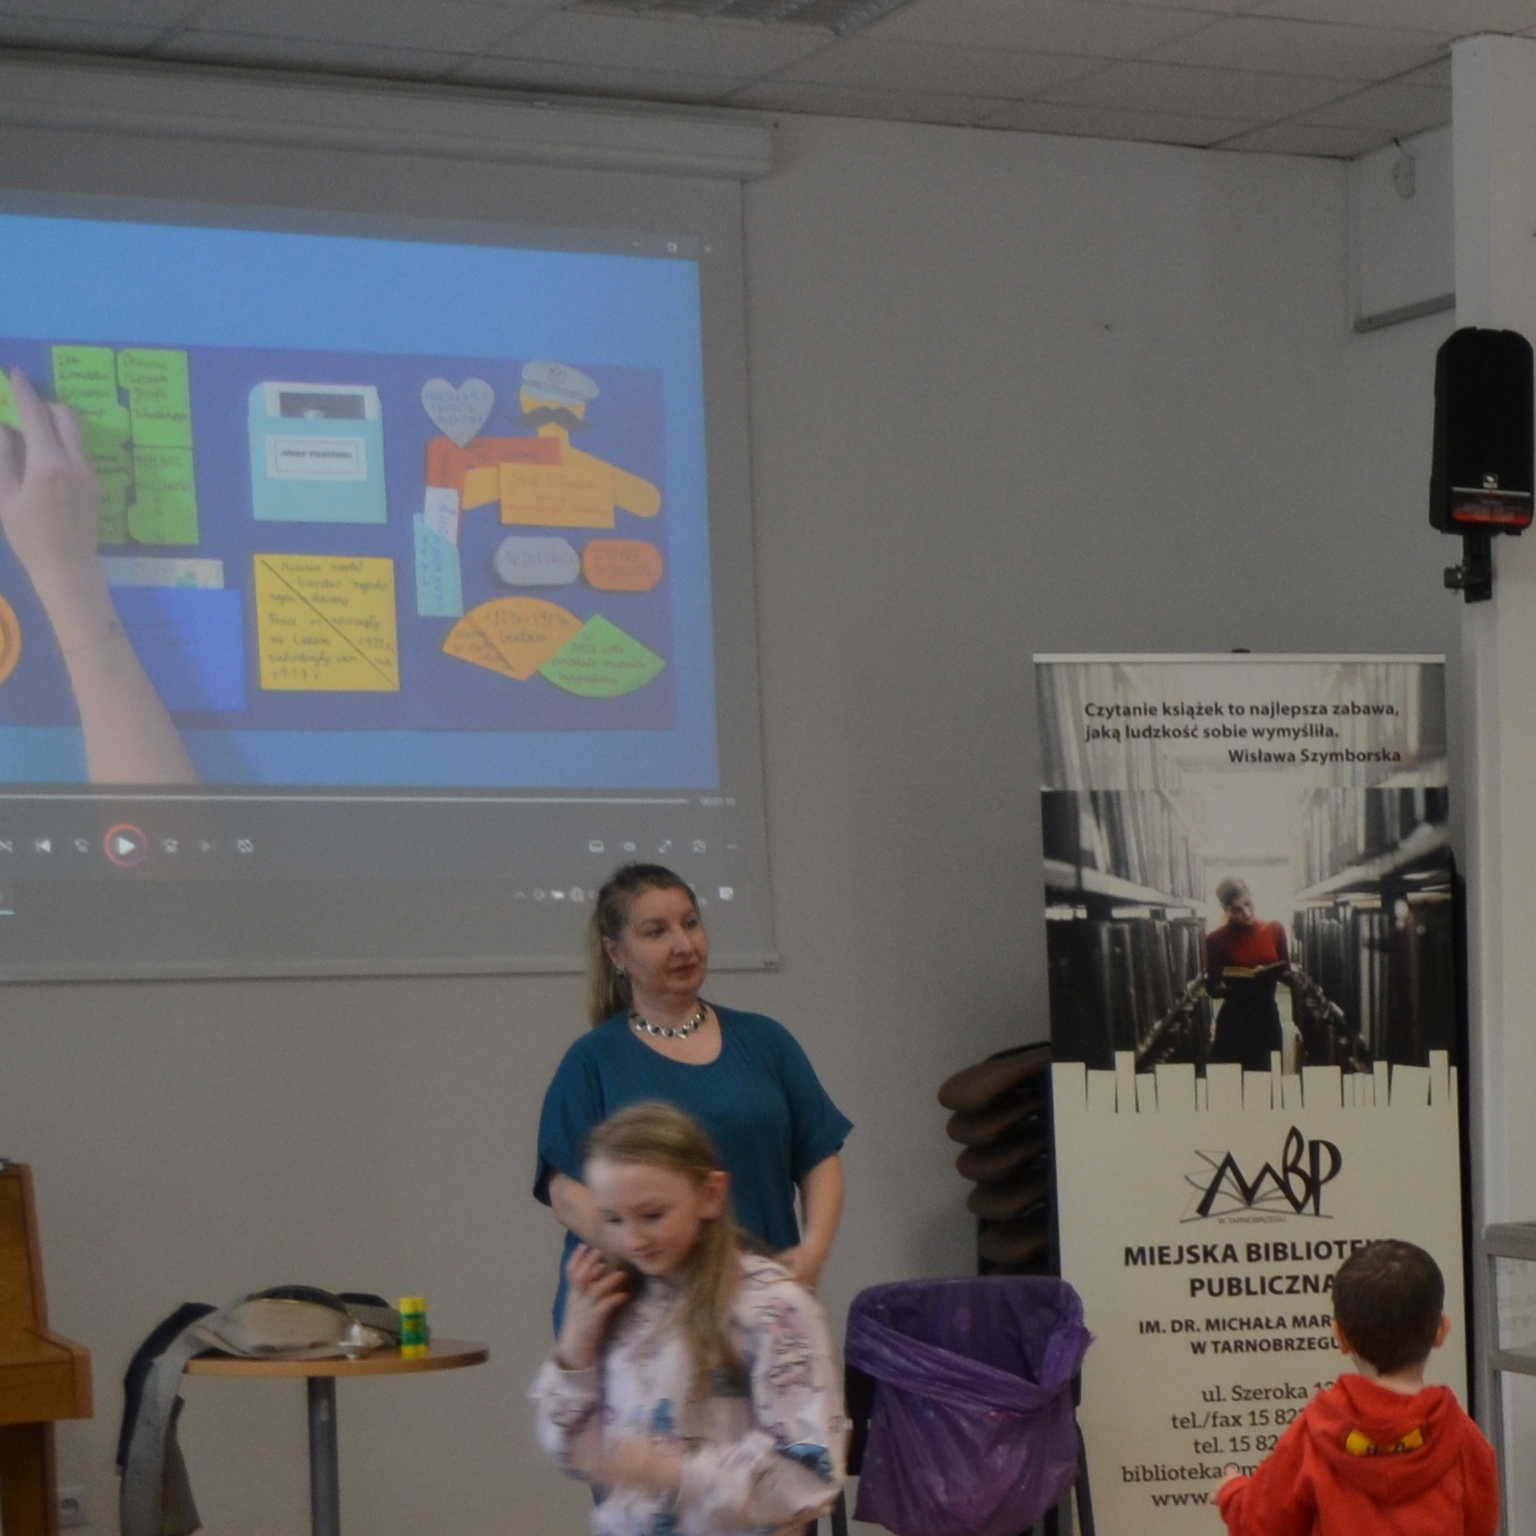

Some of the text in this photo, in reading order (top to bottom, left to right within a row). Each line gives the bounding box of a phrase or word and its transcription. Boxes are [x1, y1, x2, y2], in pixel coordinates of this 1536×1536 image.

[1084, 701, 1399, 720] Czytanie książek to najlepsza zabawa,
[1085, 722, 1339, 742] jaką ludzkość sobie wymyśliła.
[1228, 748, 1401, 766] Wisława Szymborska
[1124, 1239, 1376, 1266] MIEJSKA BIBLIOTE
[1189, 1273, 1336, 1298] PUBLICZNA
[1138, 1319, 1166, 1334] IM.
[1171, 1318, 1200, 1333] DR.
[1205, 1315, 1287, 1332] MICHAŁA
[1190, 1340, 1207, 1354] W
[1201, 1385, 1226, 1403] ul.
[1231, 1383, 1308, 1402] Szeroka
[1171, 1410, 1242, 1429] tel./fax
[1248, 1409, 1270, 1426] 15
[1193, 1436, 1224, 1454] tel.
[1229, 1436, 1250, 1452] 15
